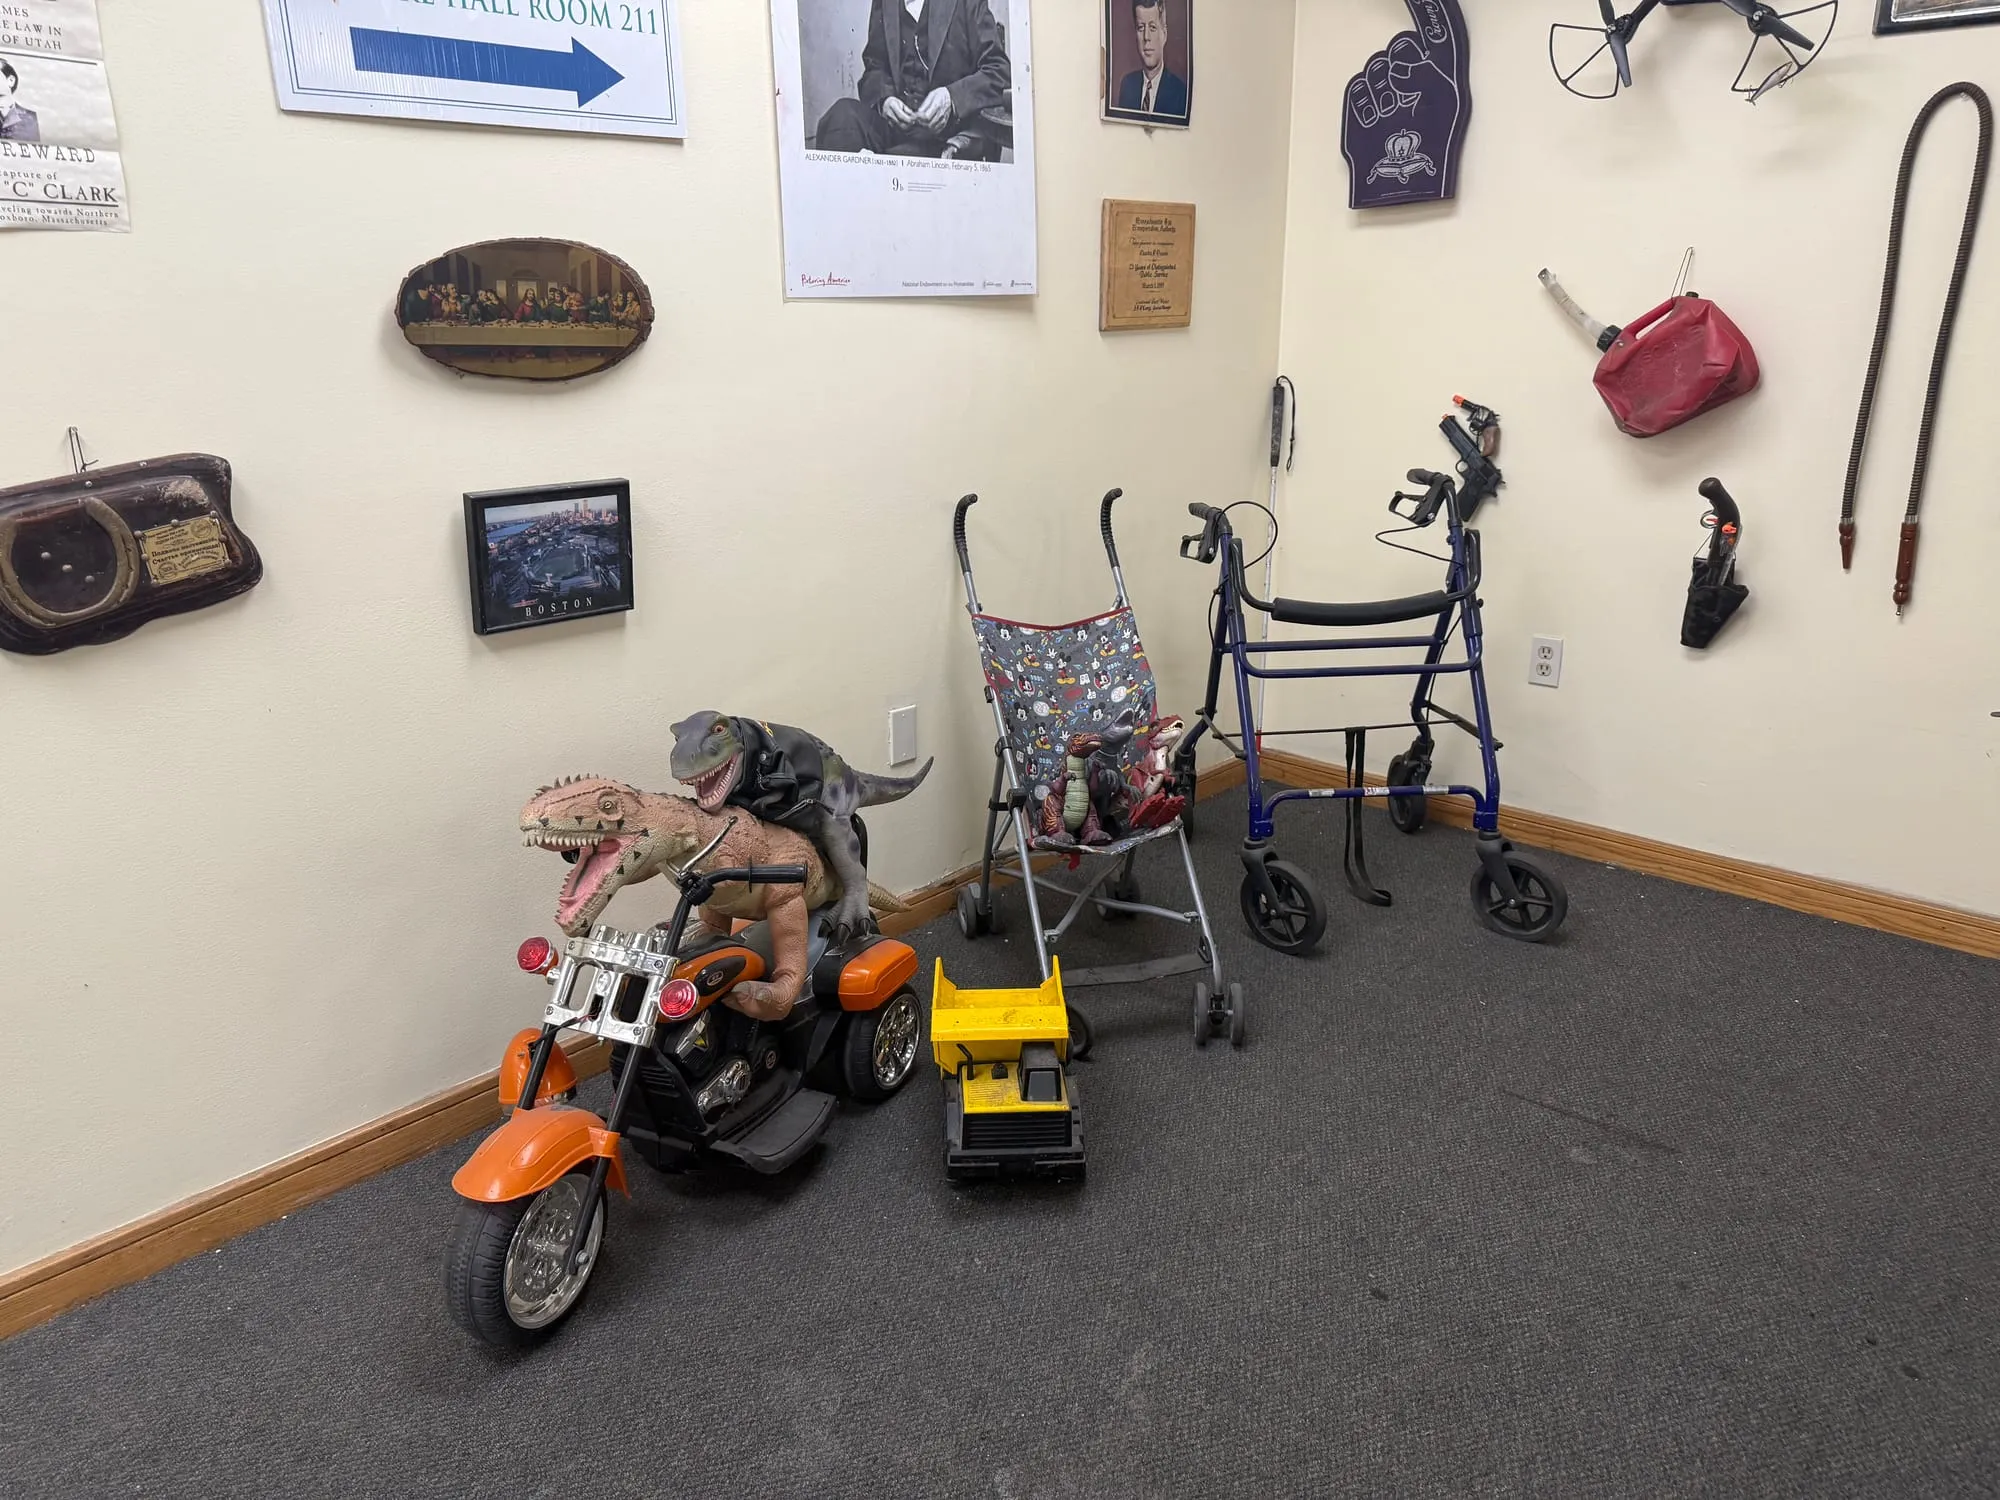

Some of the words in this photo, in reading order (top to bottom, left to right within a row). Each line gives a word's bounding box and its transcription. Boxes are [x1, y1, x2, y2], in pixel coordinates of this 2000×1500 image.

[529, 0, 613, 29] ROOM
[619, 4, 659, 35] 211
[1424, 4, 1448, 44] Crown
[14, 21, 43, 33] LAW
[48, 25, 62, 36] IN
[1, 34, 20, 45] OF
[24, 36, 62, 50] UTAH
[1, 141, 95, 163] REWARD
[805, 153, 841, 163] ALEXANDER
[843, 155, 871, 165] GARDNER
[0, 169, 41, 179] apture
[46, 171, 57, 180] of
[4, 180, 34, 197] "C"
[43, 183, 118, 203] CLARK
[36, 206, 73, 216] towards
[76, 208, 119, 218] Northern
[525, 596, 593, 617] BOSTON
